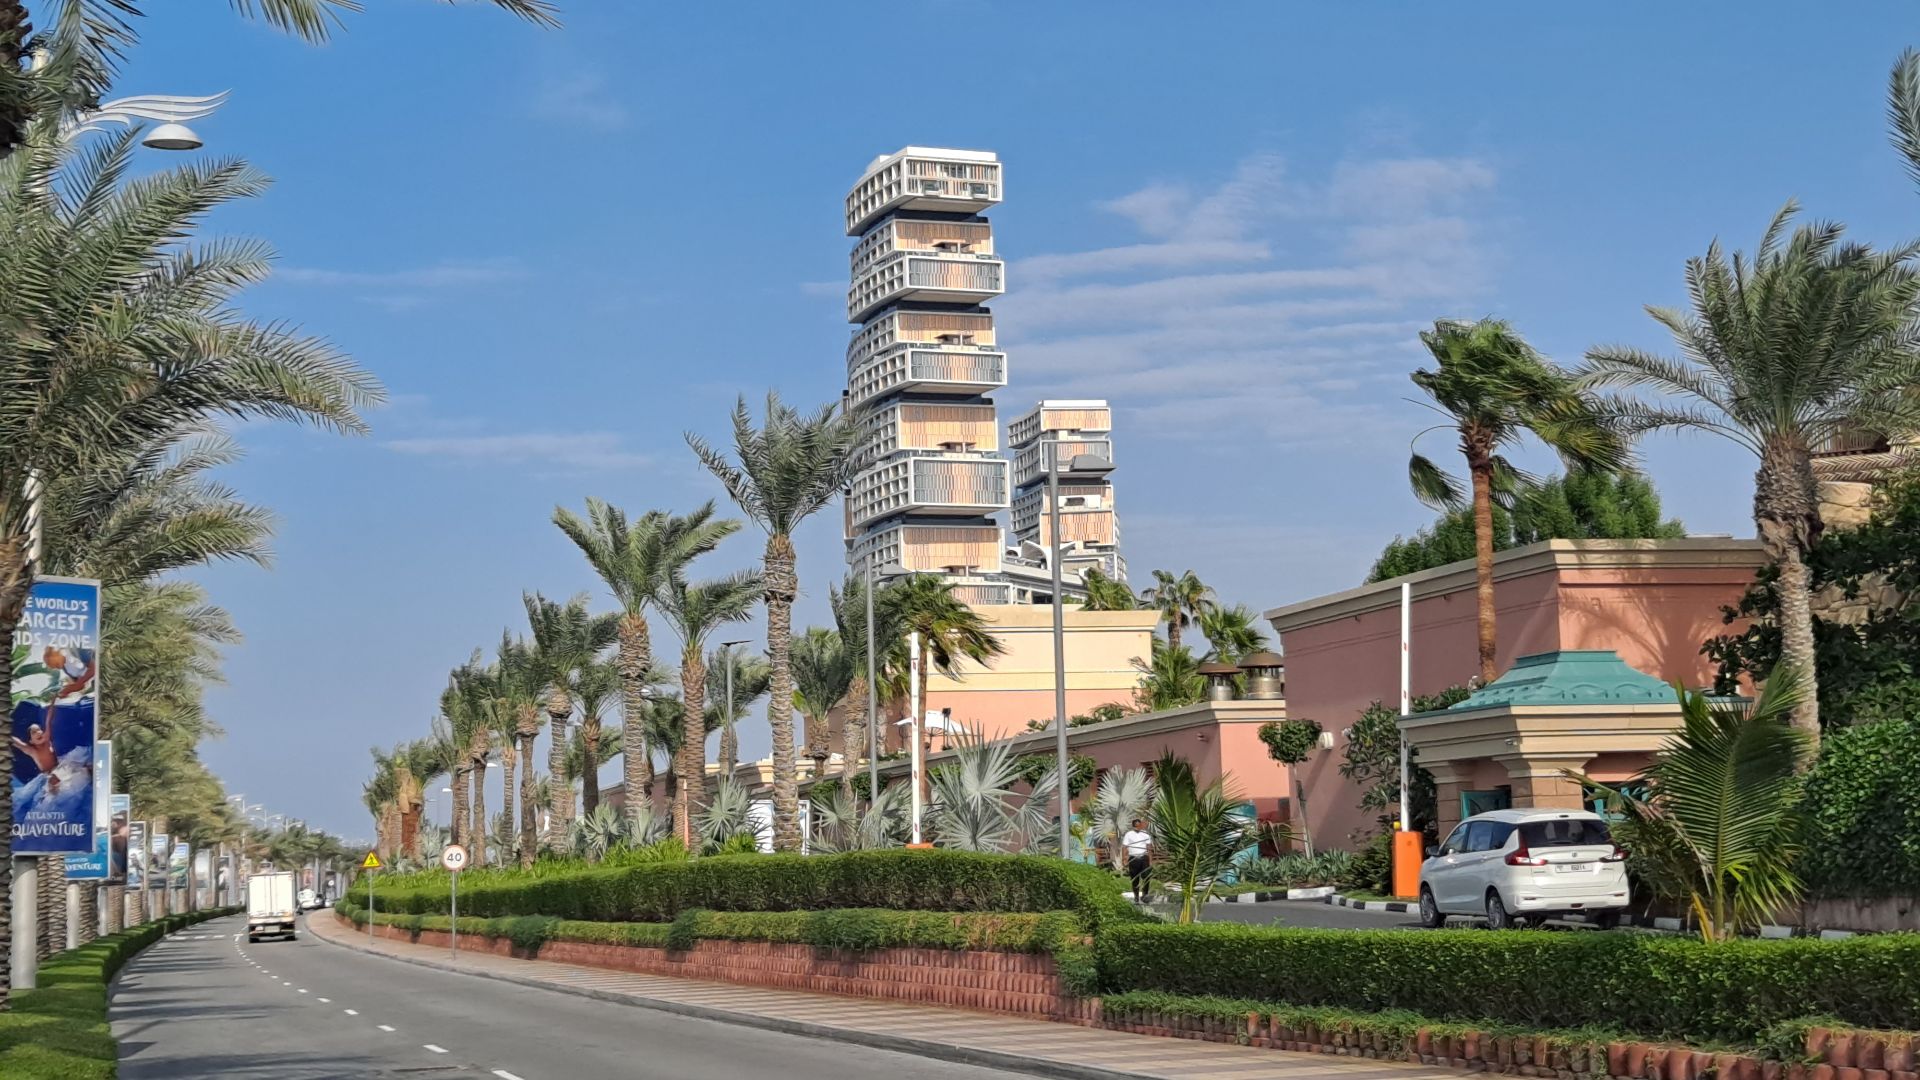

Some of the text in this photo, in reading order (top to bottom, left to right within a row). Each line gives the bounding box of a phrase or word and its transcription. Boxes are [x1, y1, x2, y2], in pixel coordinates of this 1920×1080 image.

[35, 597, 88, 611] WORLD'S
[17, 611, 88, 631] ARGEST
[15, 630, 91, 649] IDS ZONE
[11, 822, 86, 840] QUAVENTURE
[447, 853, 462, 862] 40
